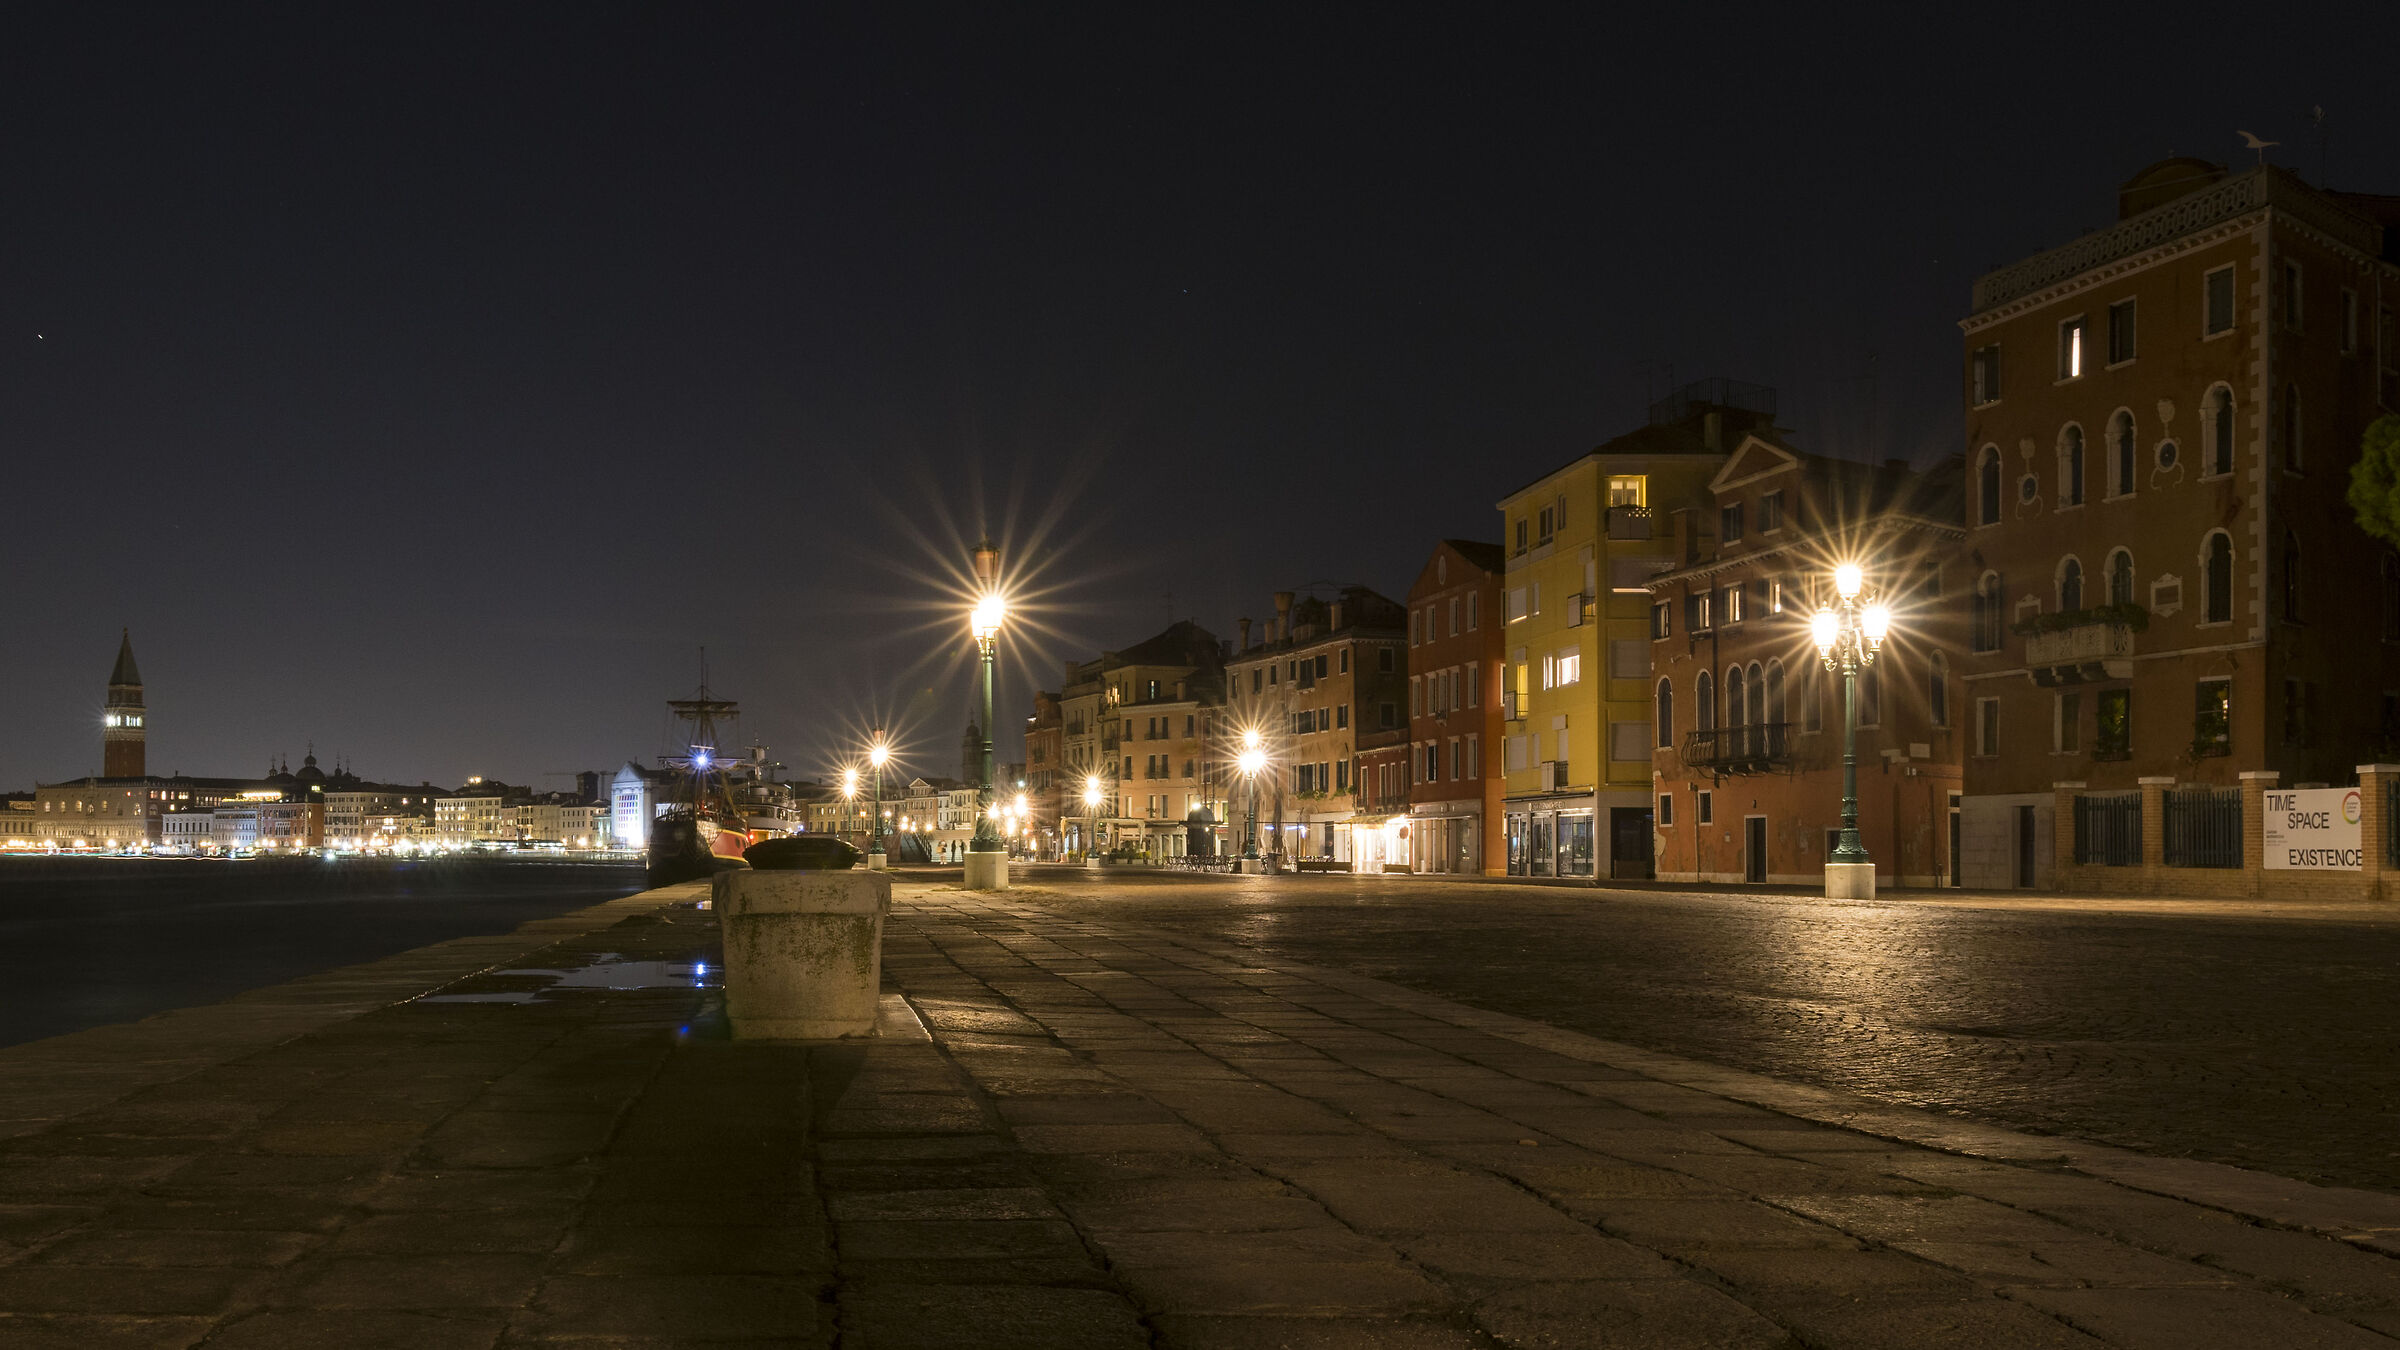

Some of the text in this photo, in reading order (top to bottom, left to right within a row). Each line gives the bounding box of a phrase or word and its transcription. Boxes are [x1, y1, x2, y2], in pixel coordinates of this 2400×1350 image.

[2267, 795, 2296, 811] TIME
[2287, 812, 2330, 829] SPACE
[2289, 849, 2362, 866] EXISTENCE
